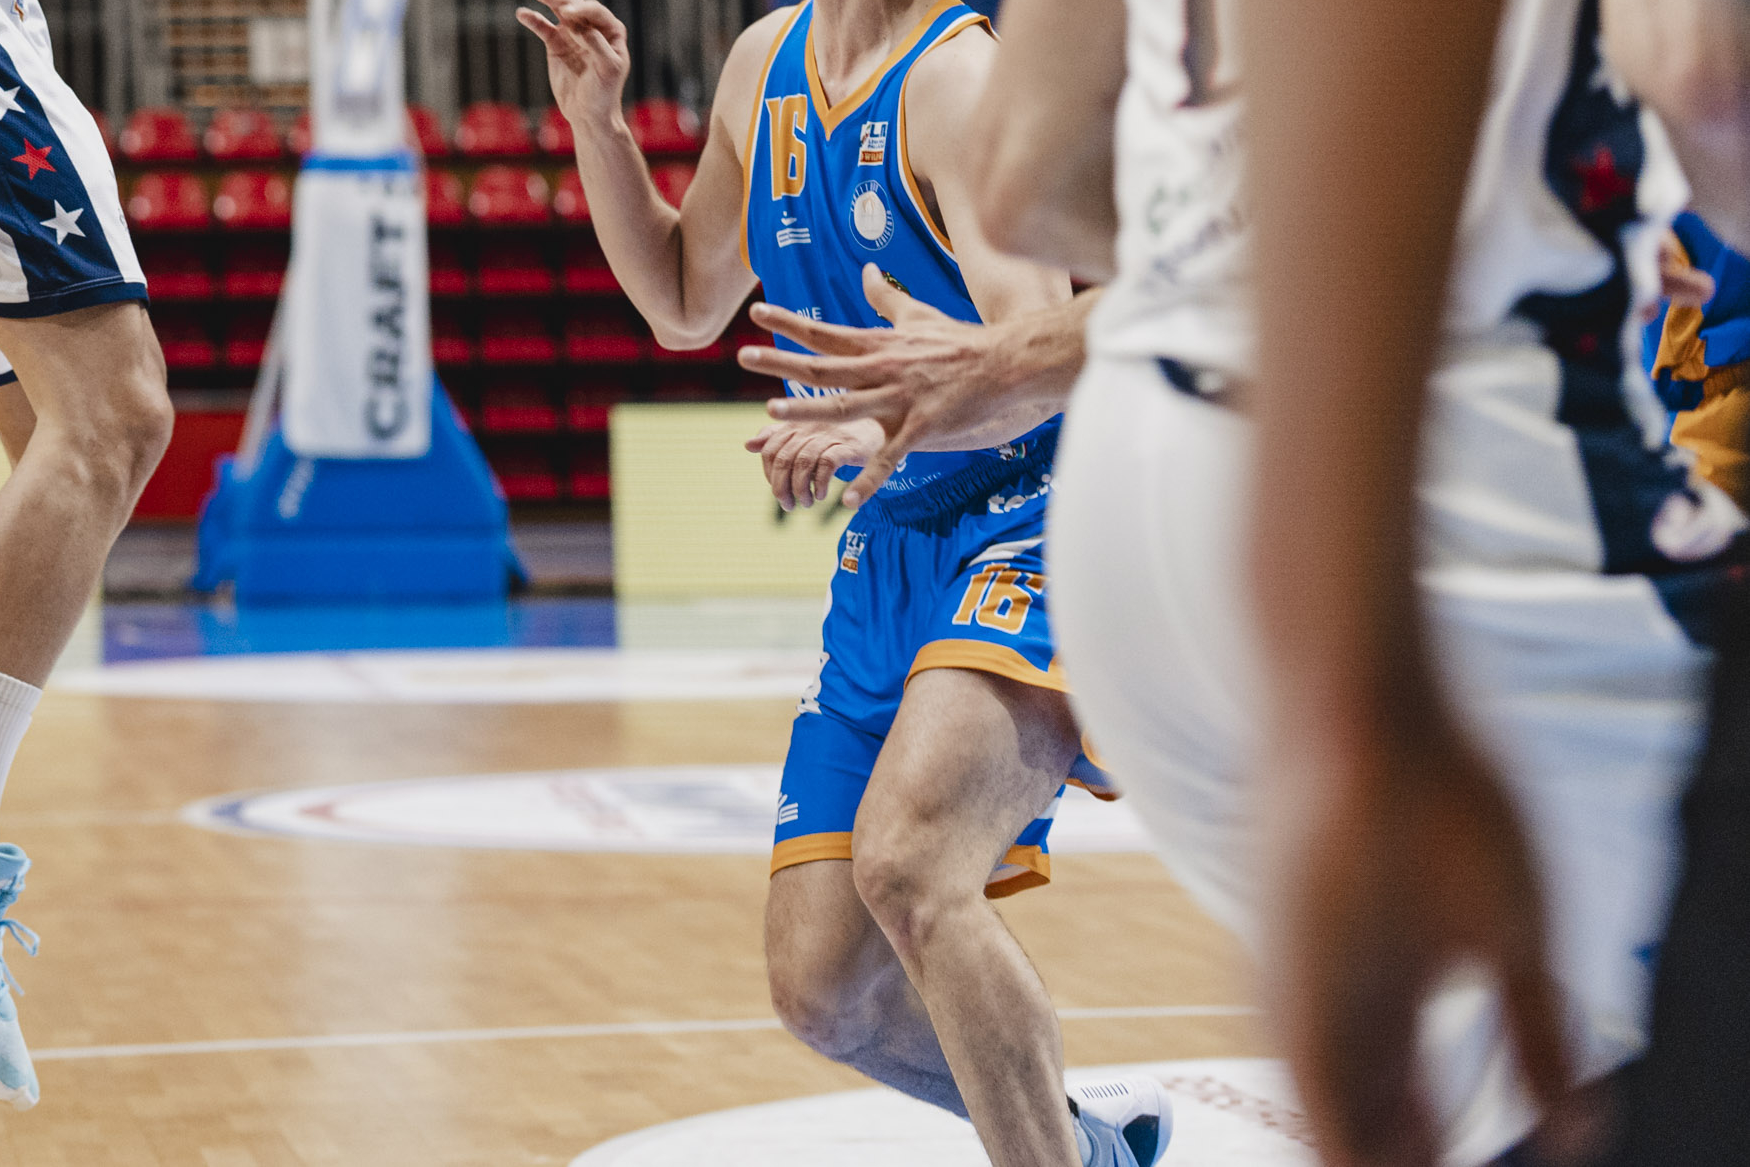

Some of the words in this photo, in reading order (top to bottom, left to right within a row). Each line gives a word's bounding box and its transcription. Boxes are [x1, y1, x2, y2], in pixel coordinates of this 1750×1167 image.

[765, 93, 808, 201] 16
[362, 214, 409, 441] CRAFT
[951, 562, 1050, 635] 16
